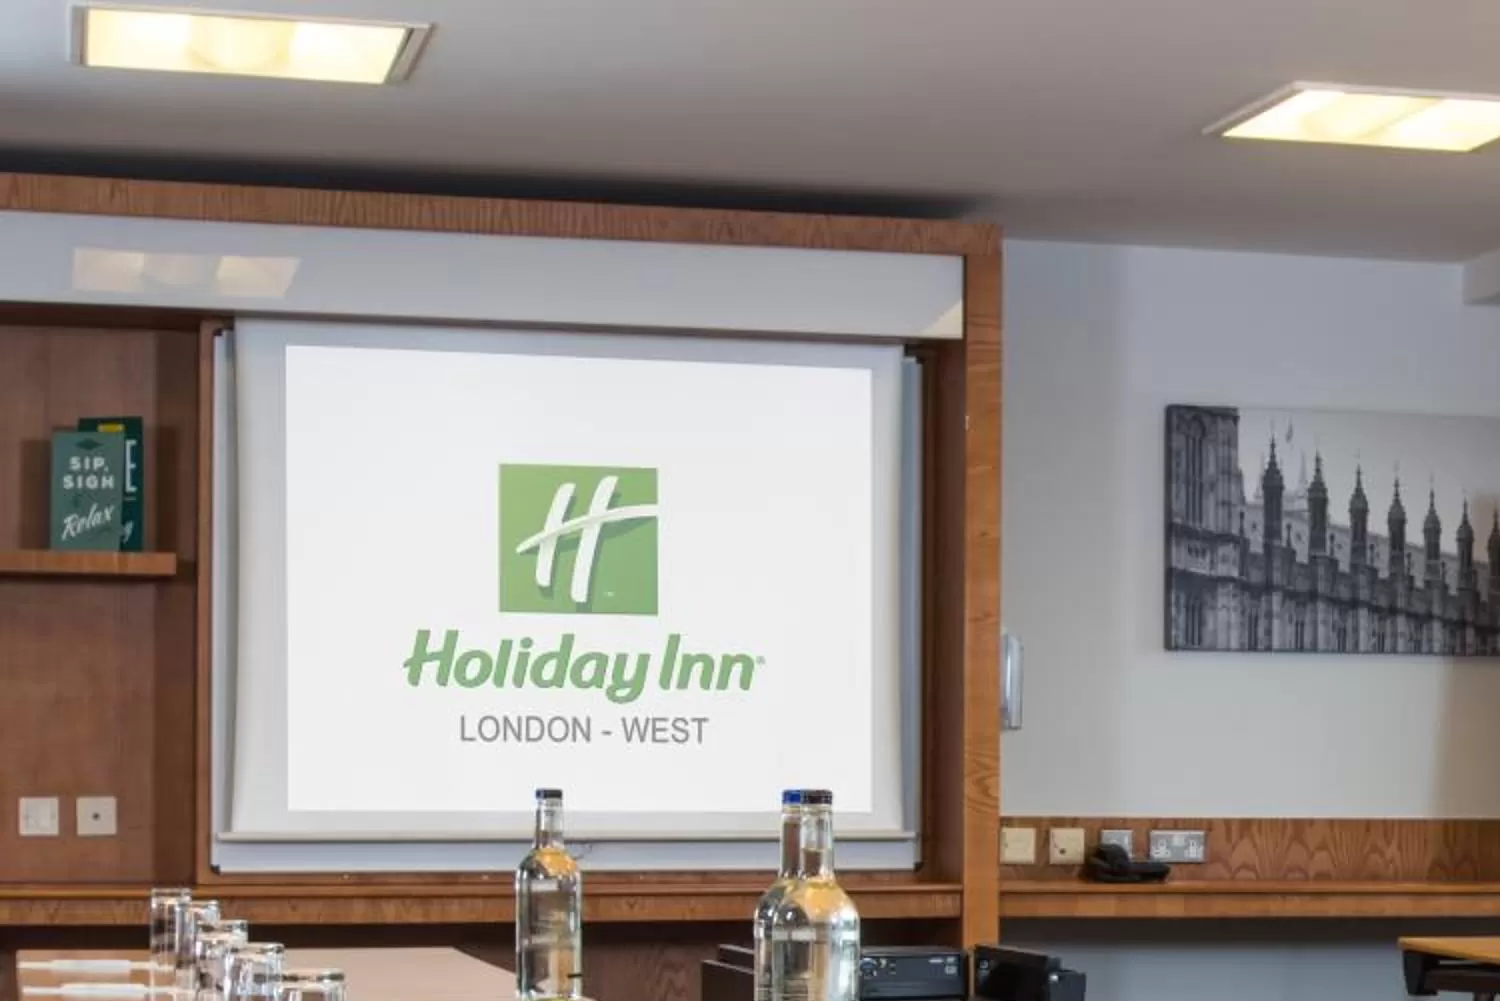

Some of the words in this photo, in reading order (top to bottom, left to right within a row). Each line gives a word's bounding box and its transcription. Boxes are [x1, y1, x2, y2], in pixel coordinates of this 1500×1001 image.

[63, 475, 115, 490] SIGH
[61, 502, 116, 541] Relax
[402, 629, 652, 705] Holiday
[658, 633, 756, 692] Inn
[460, 714, 592, 743] LONDON
[620, 716, 711, 745] WEST
